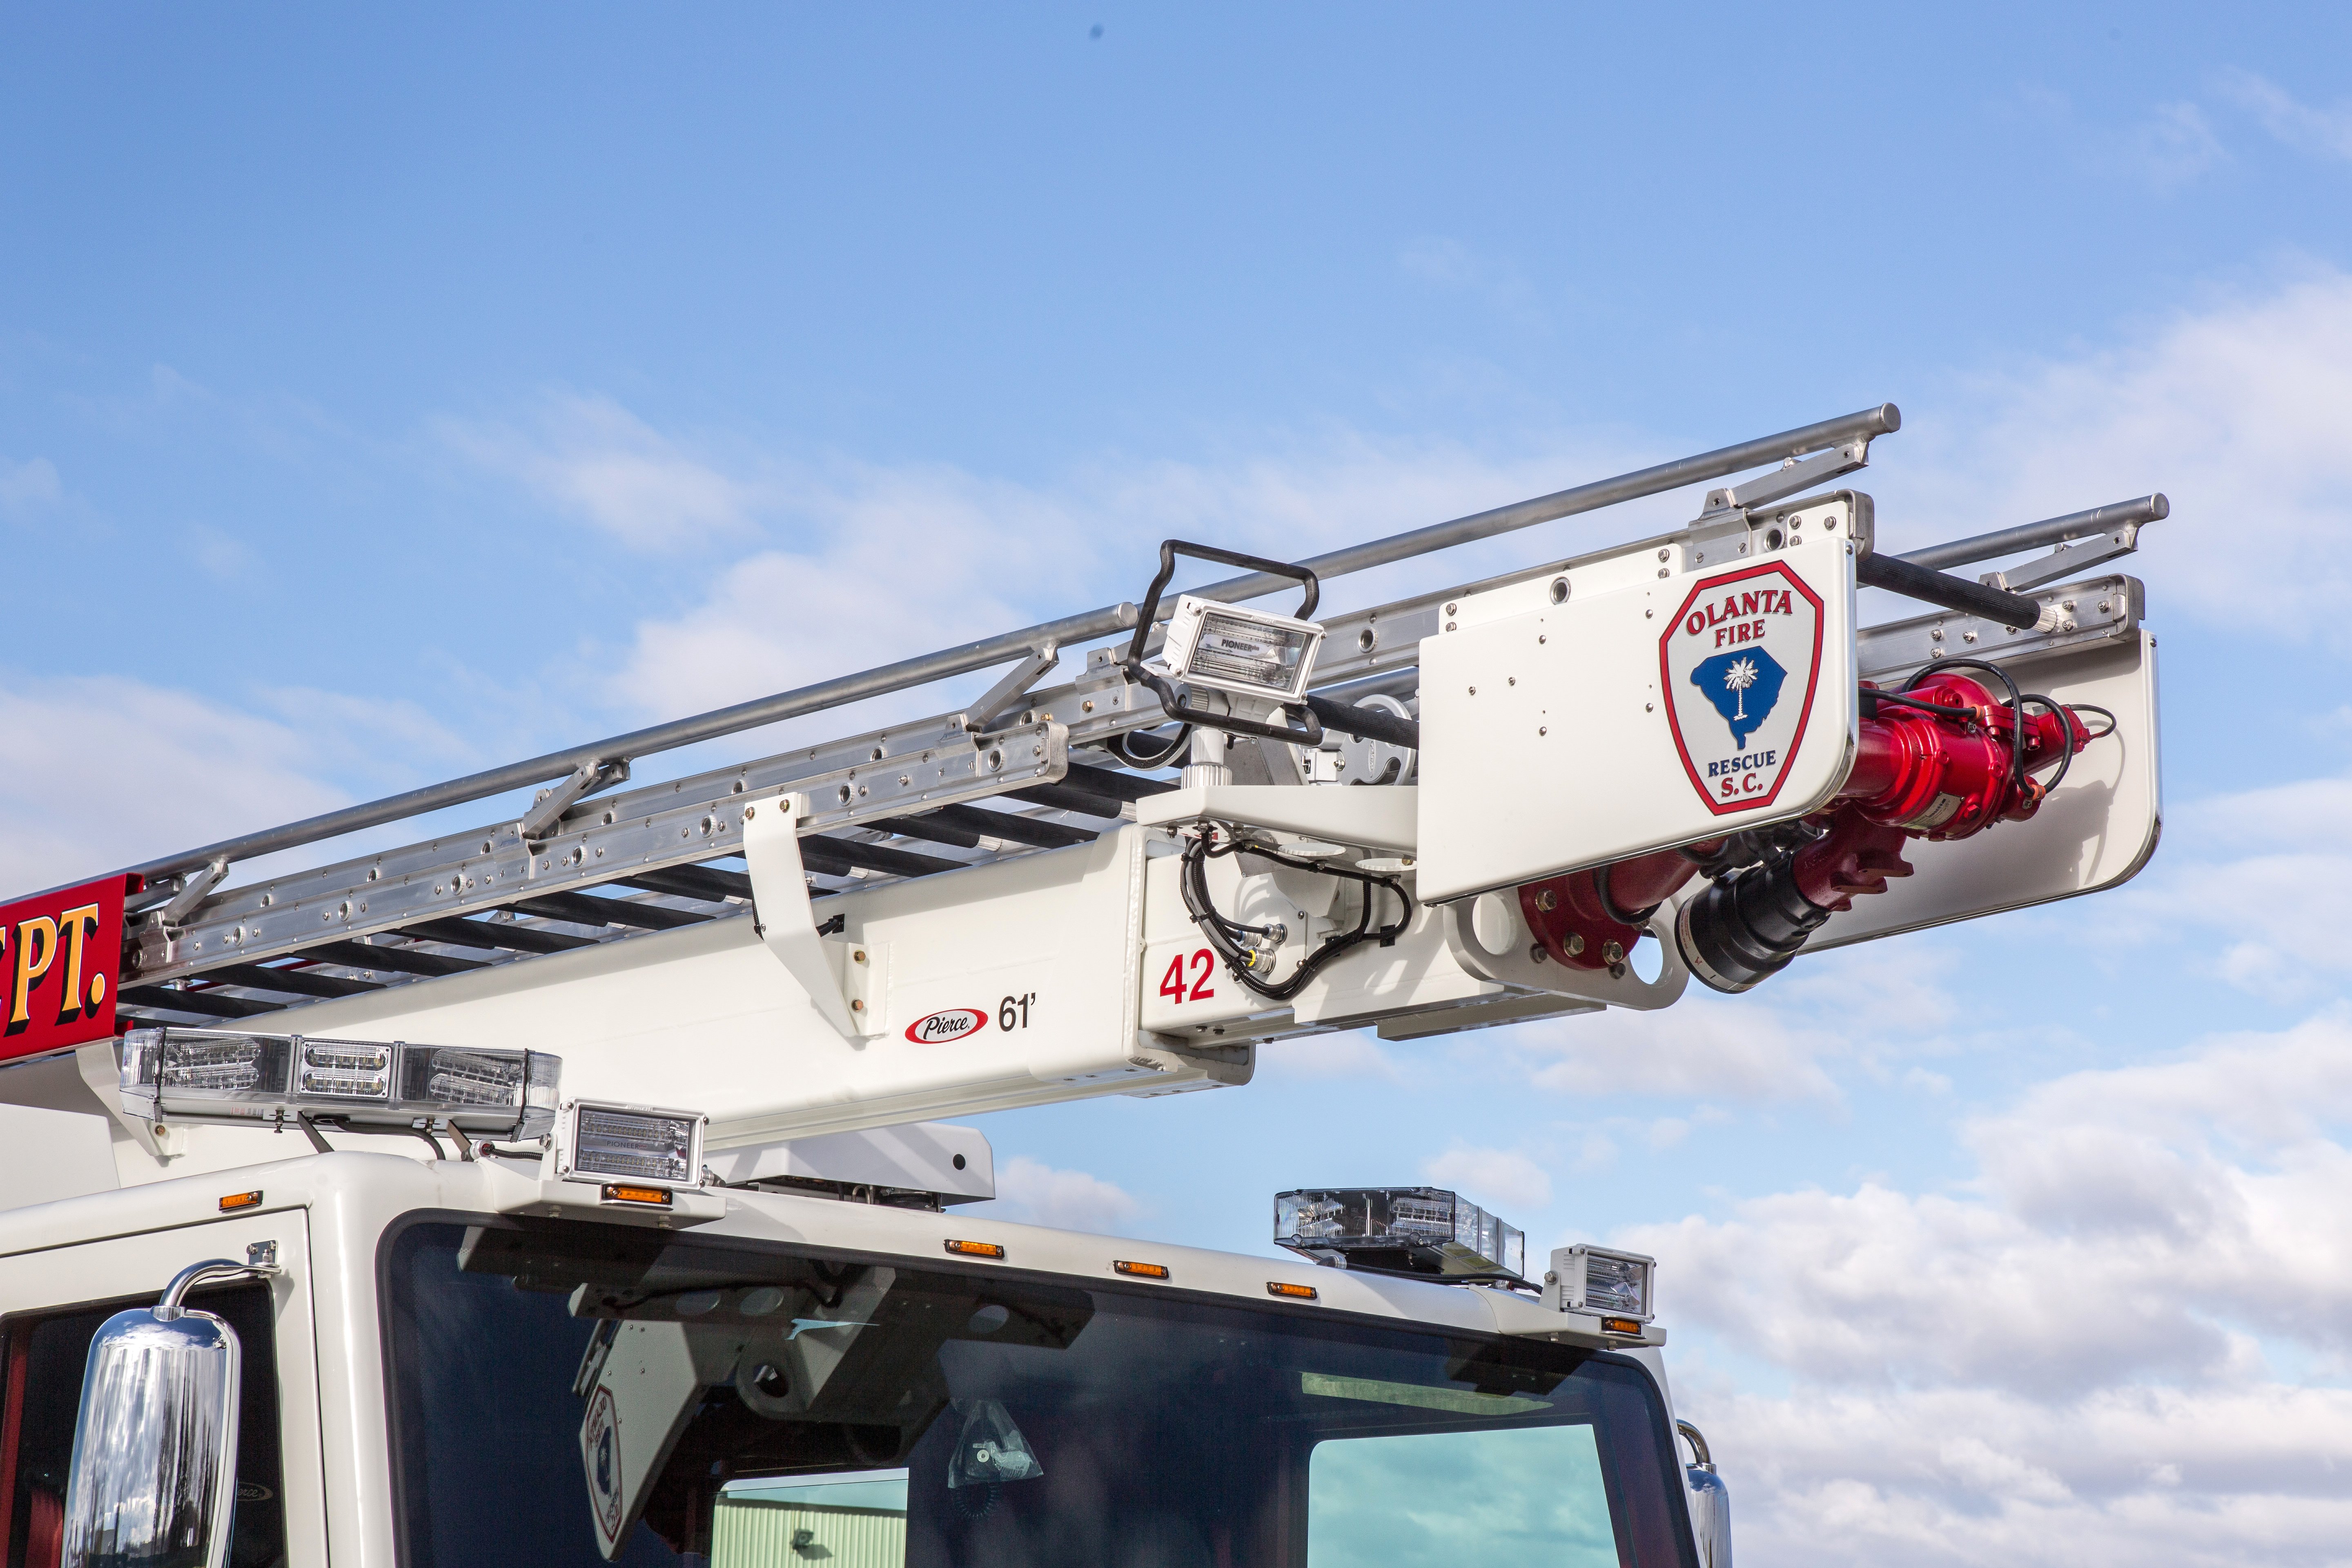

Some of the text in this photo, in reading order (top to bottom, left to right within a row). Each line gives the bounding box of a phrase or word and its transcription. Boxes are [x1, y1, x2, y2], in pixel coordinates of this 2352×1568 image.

[1686, 590, 1793, 635] OLANTA
[1715, 619, 1765, 648] FIRE
[1708, 750, 1776, 778] RESCUE
[1160, 948, 1214, 1004] 42
[923, 1016, 968, 1040] Pierce
